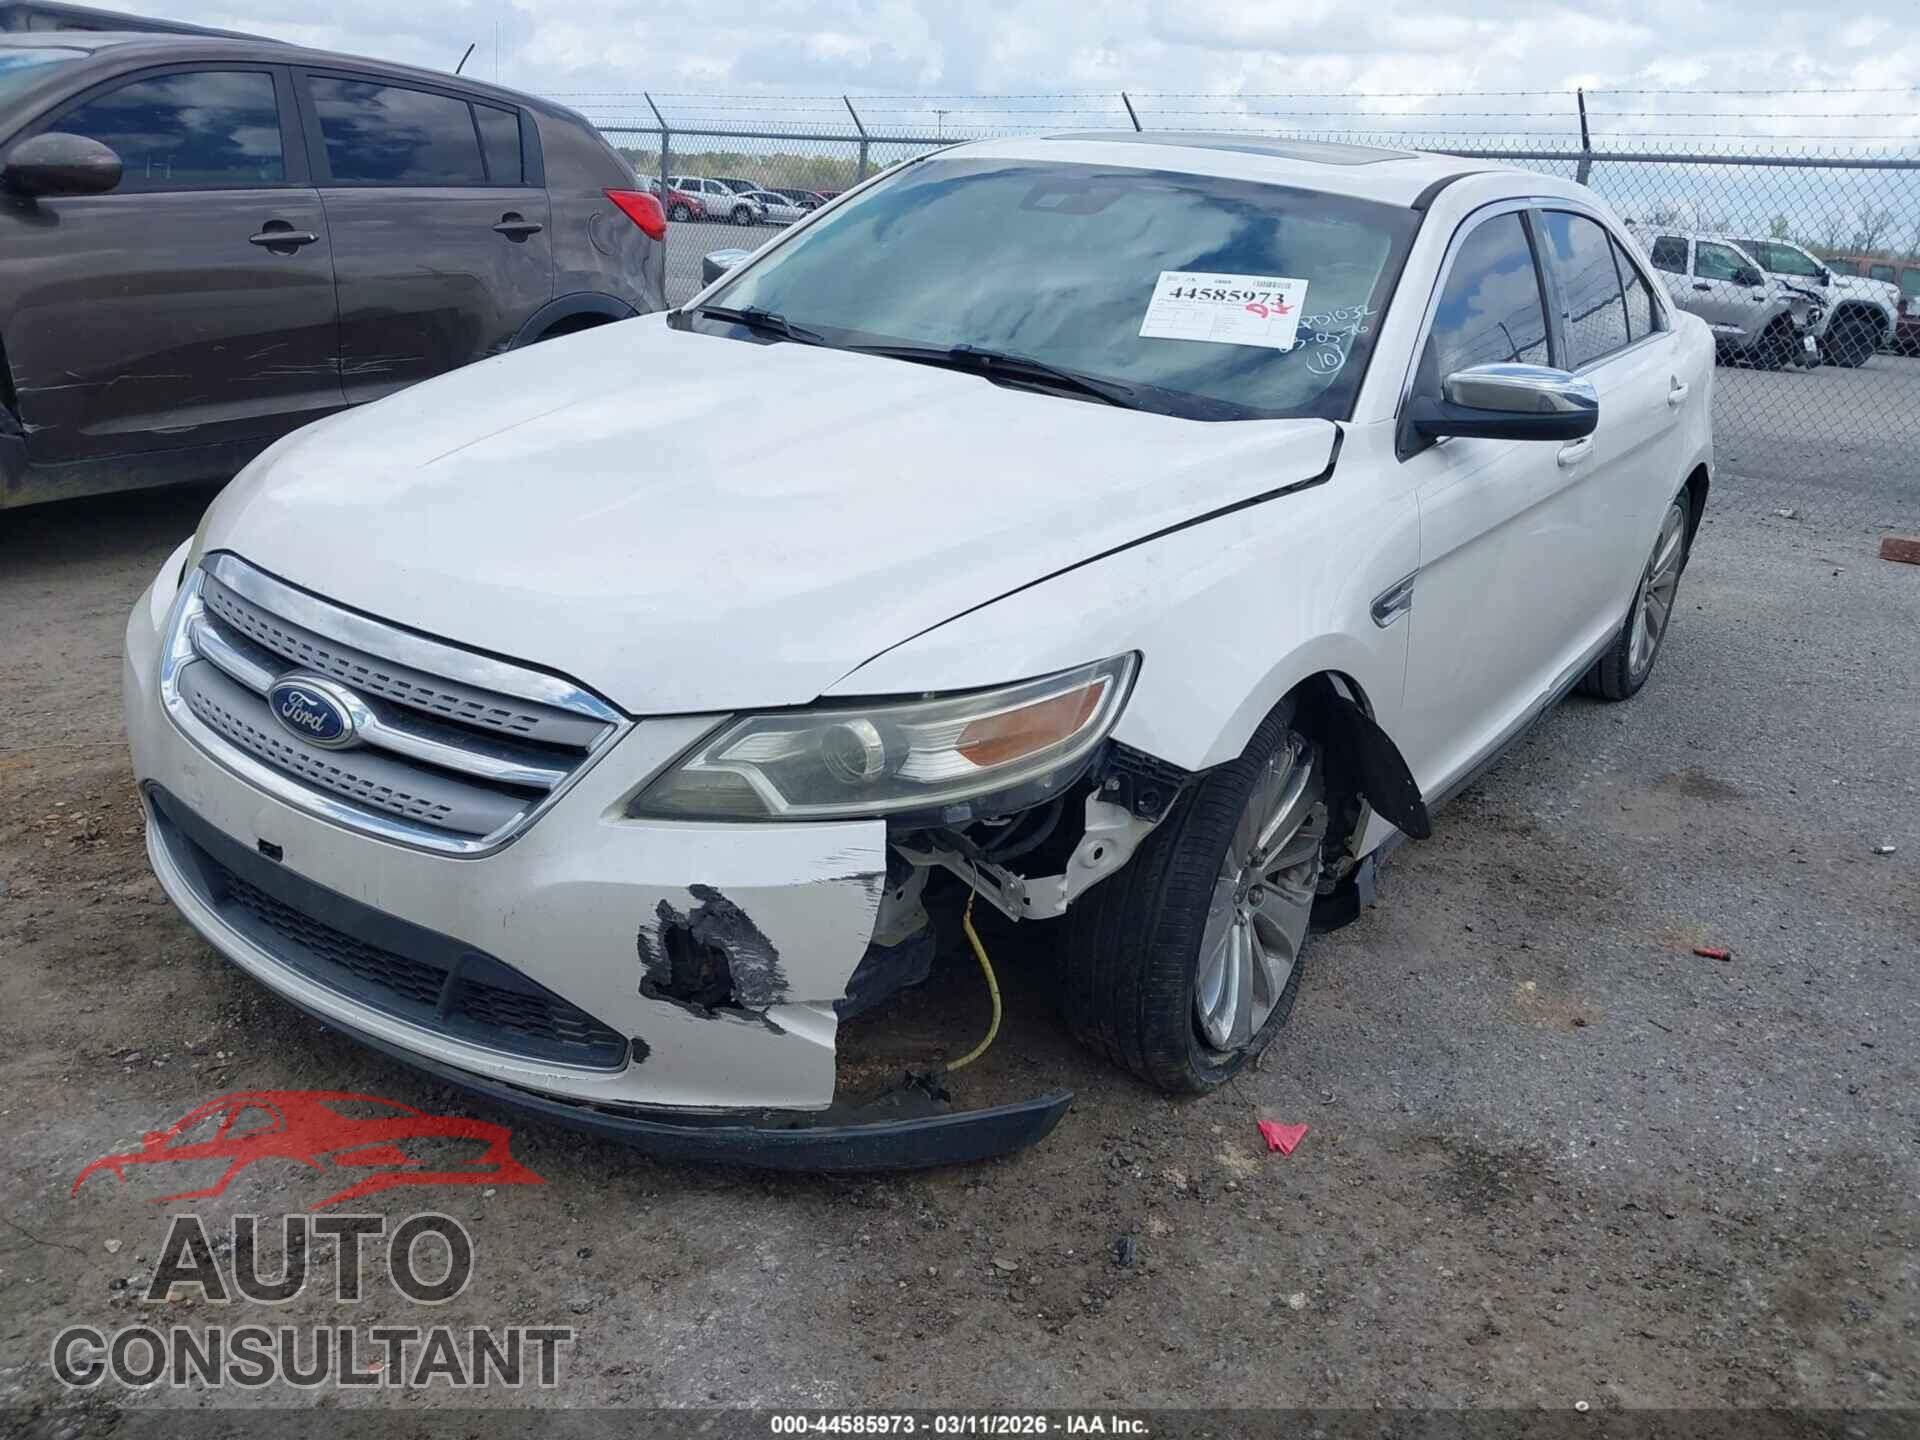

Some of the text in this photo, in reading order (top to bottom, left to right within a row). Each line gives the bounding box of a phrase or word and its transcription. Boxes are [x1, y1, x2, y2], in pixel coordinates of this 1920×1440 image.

[1169, 286, 1285, 305] 44585973
[1297, 305, 1377, 329] PD1032
[282, 691, 328, 731] Ford
